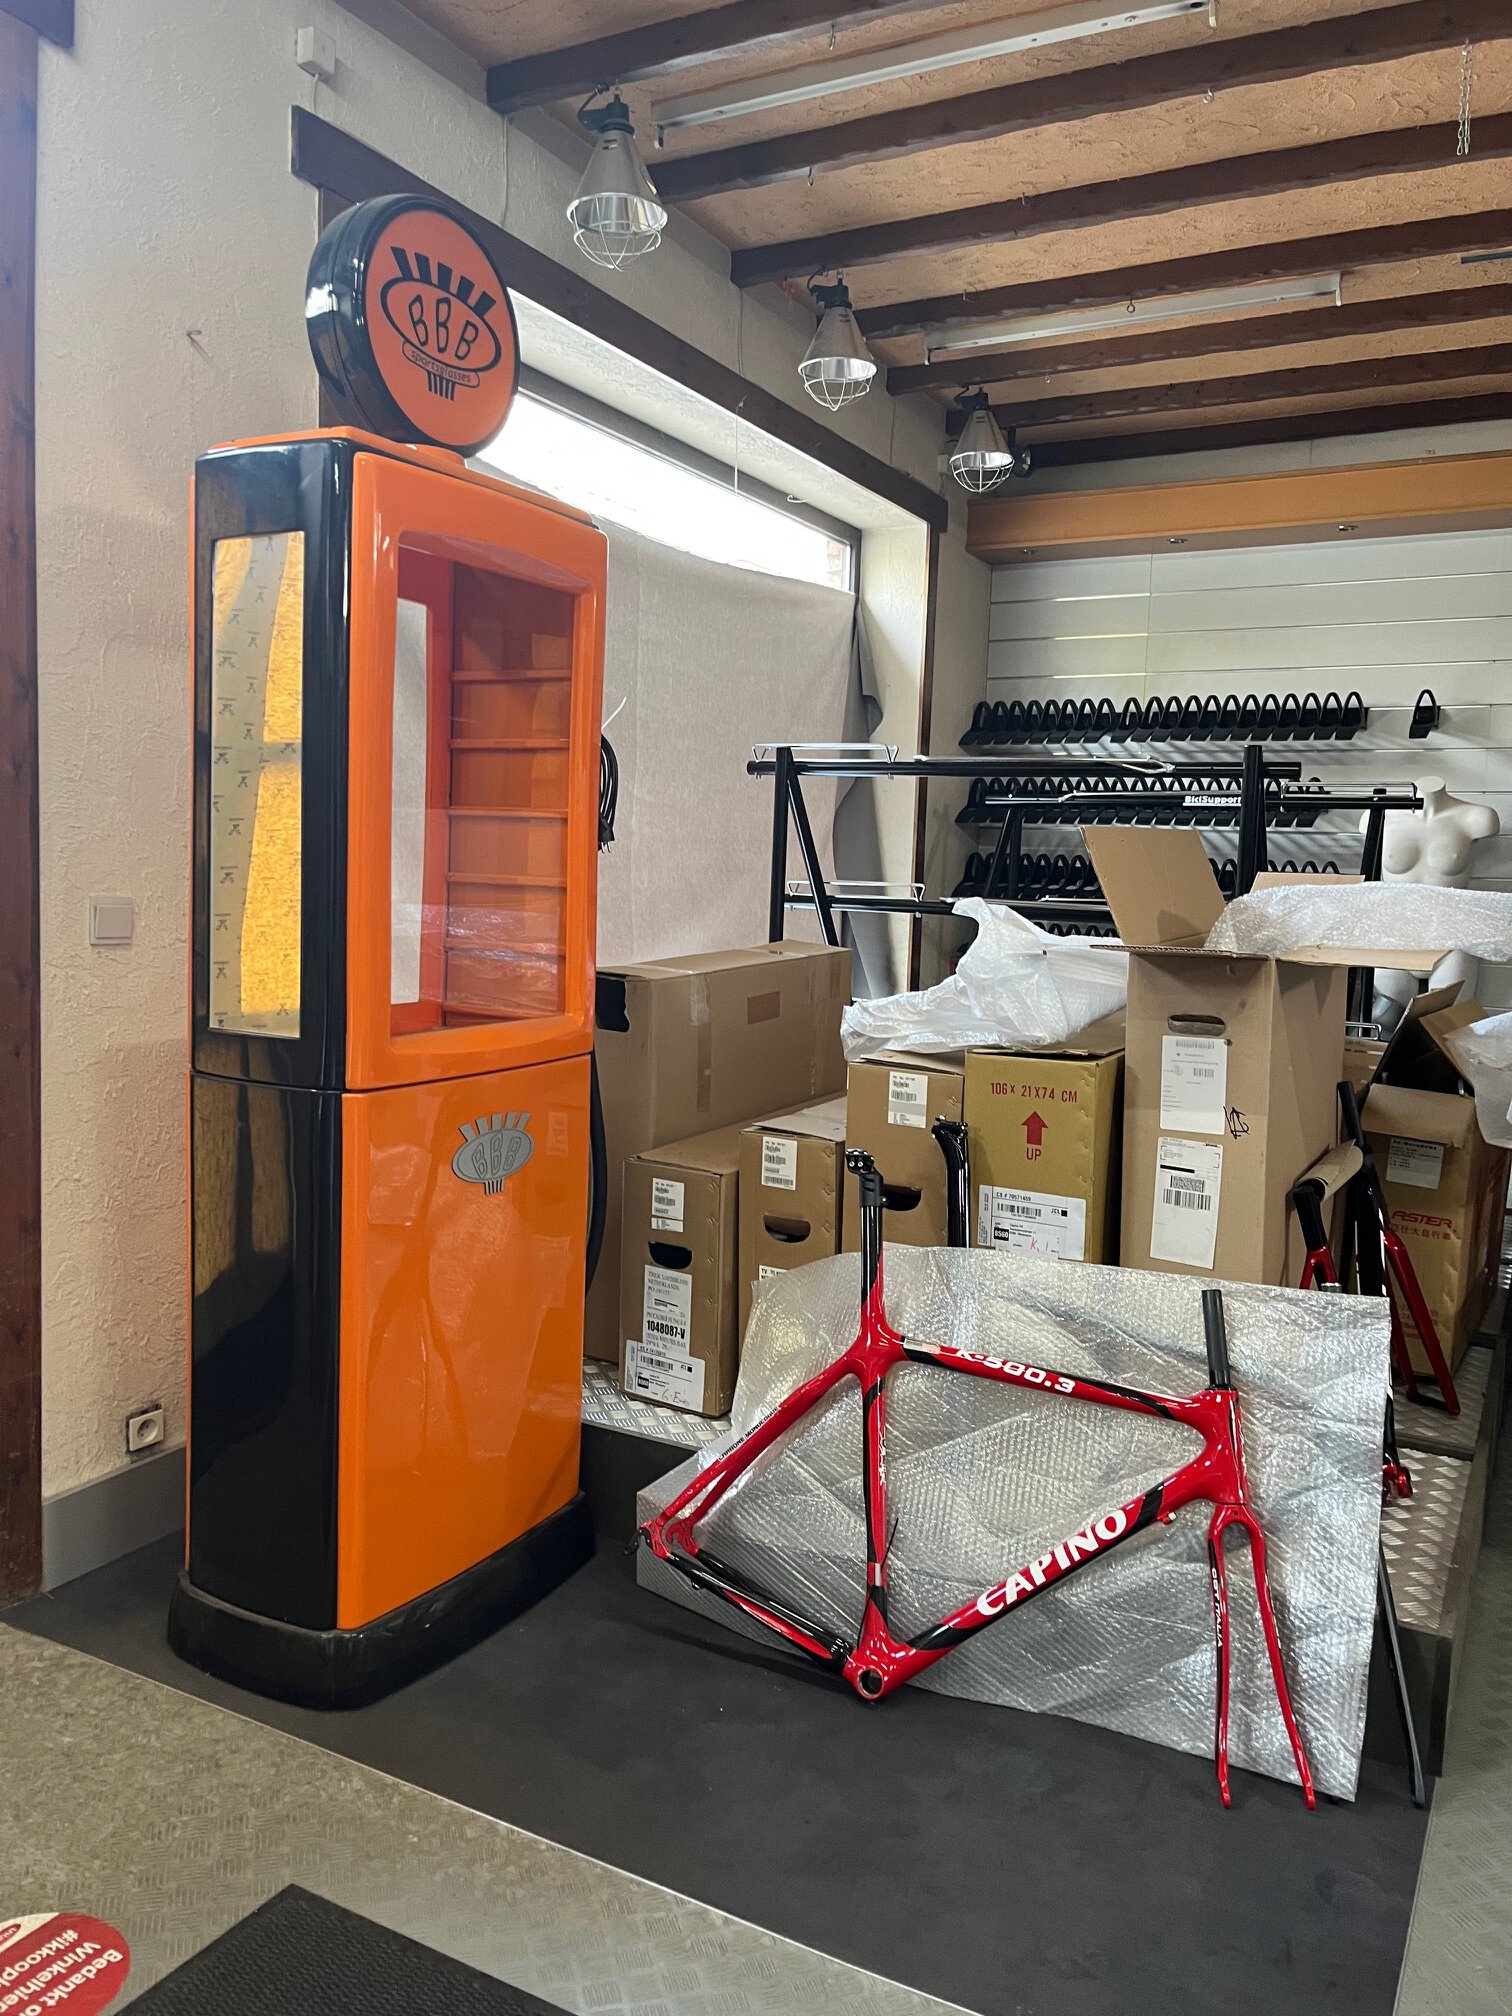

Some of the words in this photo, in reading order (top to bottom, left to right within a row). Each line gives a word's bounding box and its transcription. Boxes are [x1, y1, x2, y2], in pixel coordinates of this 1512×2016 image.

[408, 294, 479, 361] BBB
[1061, 1090, 1078, 1103] CM
[471, 1130, 521, 1178] BBB
[1026, 1147, 1042, 1161] UP
[976, 1509, 1127, 1616] CAPINO
[38, 1948, 124, 2007] Bedankt
